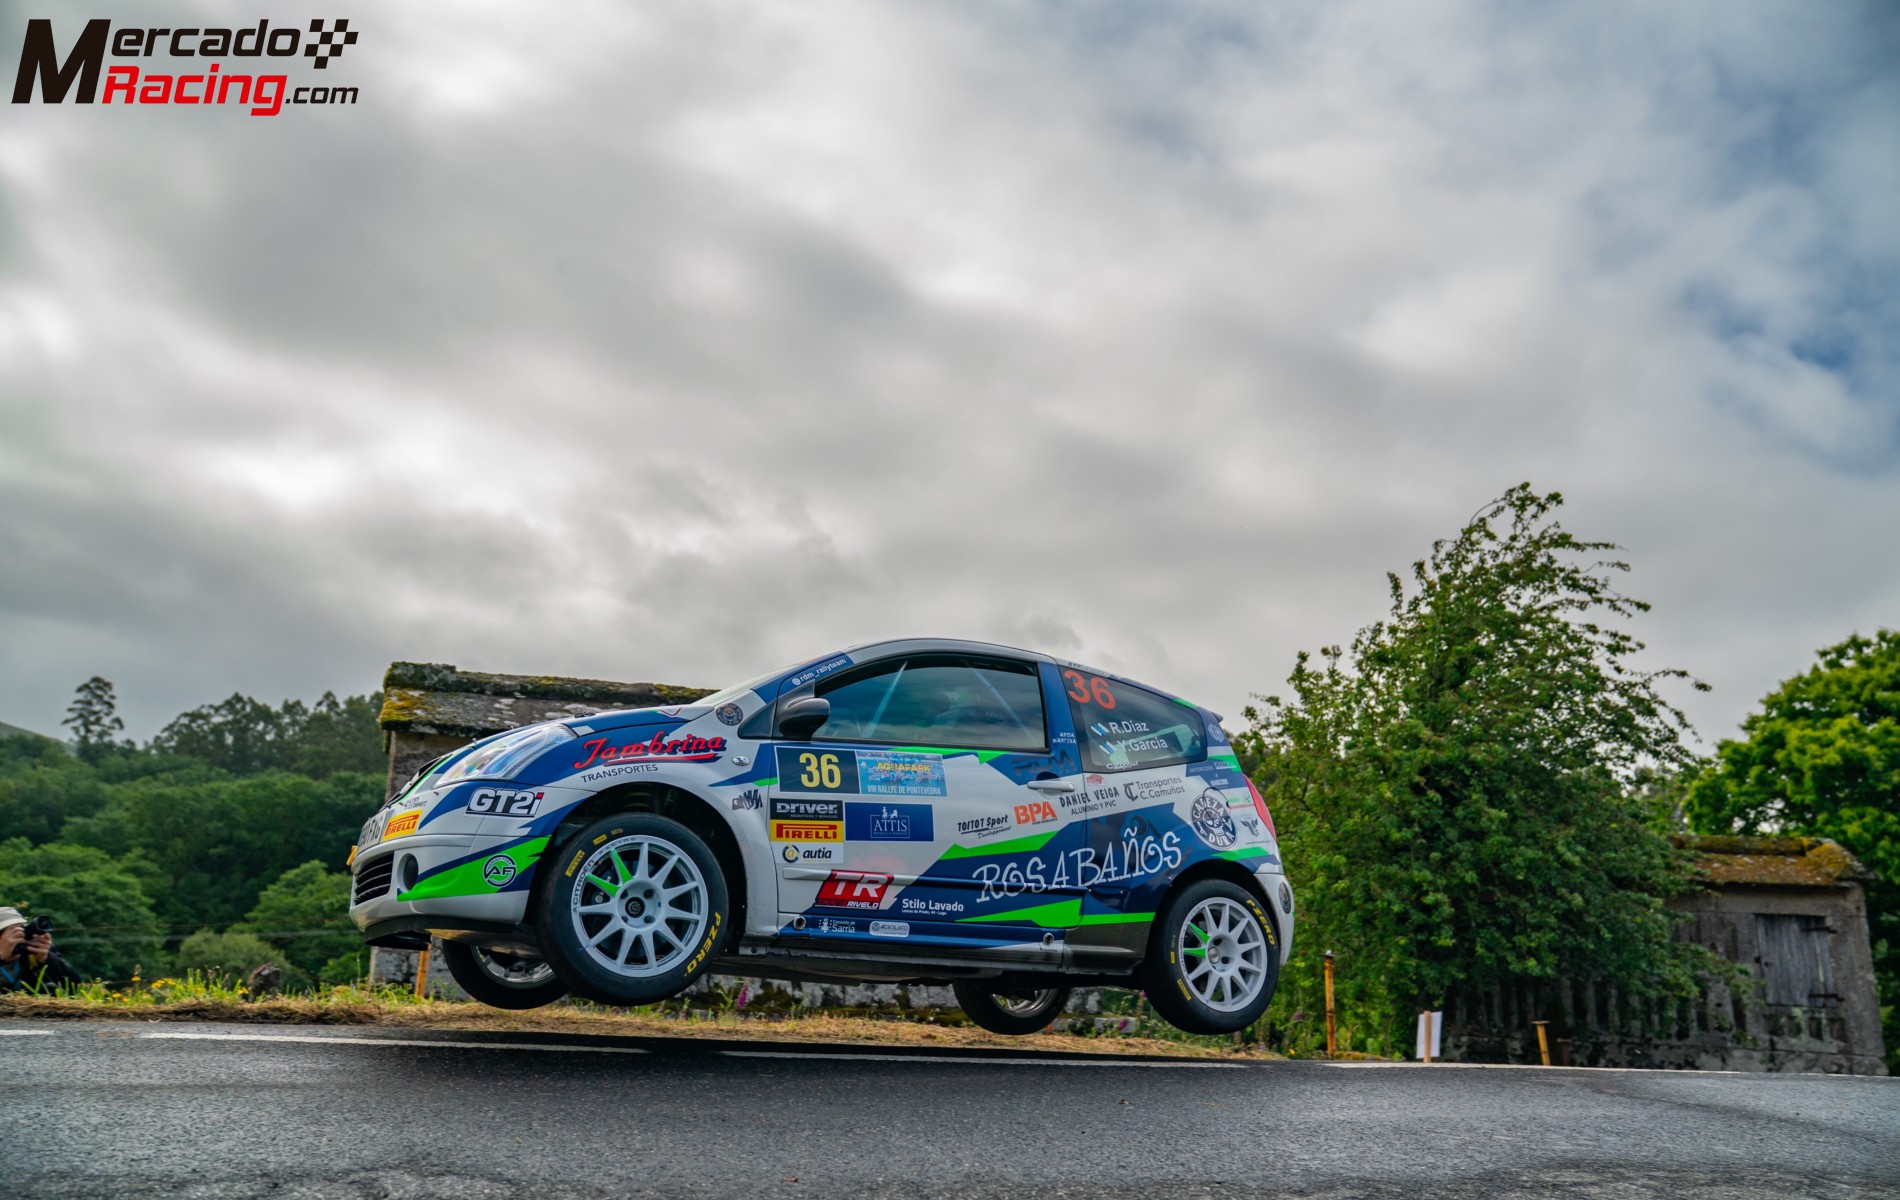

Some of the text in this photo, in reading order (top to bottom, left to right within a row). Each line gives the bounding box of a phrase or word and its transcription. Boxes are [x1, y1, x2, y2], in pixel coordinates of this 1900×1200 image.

[1064, 670, 1116, 709] 36
[1109, 720, 1149, 734] R.Díaz
[1117, 737, 1168, 753] Y.García
[581, 764, 658, 783] TRANSPORTES
[799, 753, 842, 788] 36
[867, 785, 941, 795] VIII RALLYE DE PONTEVEDRA
[1136, 776, 1182, 790] Transportes
[1059, 786, 1120, 808] DANIEL VEIGA
[1140, 785, 1185, 800] C.Camuñas
[469, 787, 545, 815] GT2i
[1071, 803, 1099, 815] ALUMINIO
[1105, 800, 1117, 809] PVC
[1014, 801, 1057, 825] BPA
[384, 814, 420, 837] PIRELLI
[776, 823, 838, 839] PIRELLI
[873, 819, 908, 832] ATTIS
[958, 814, 1009, 832] TOITOT Sport
[1209, 831, 1235, 846] DURA
[803, 847, 832, 859] autia
[834, 871, 890, 898] TR
[902, 898, 964, 912] Stilo Lavado
[832, 924, 856, 933] Sarria
